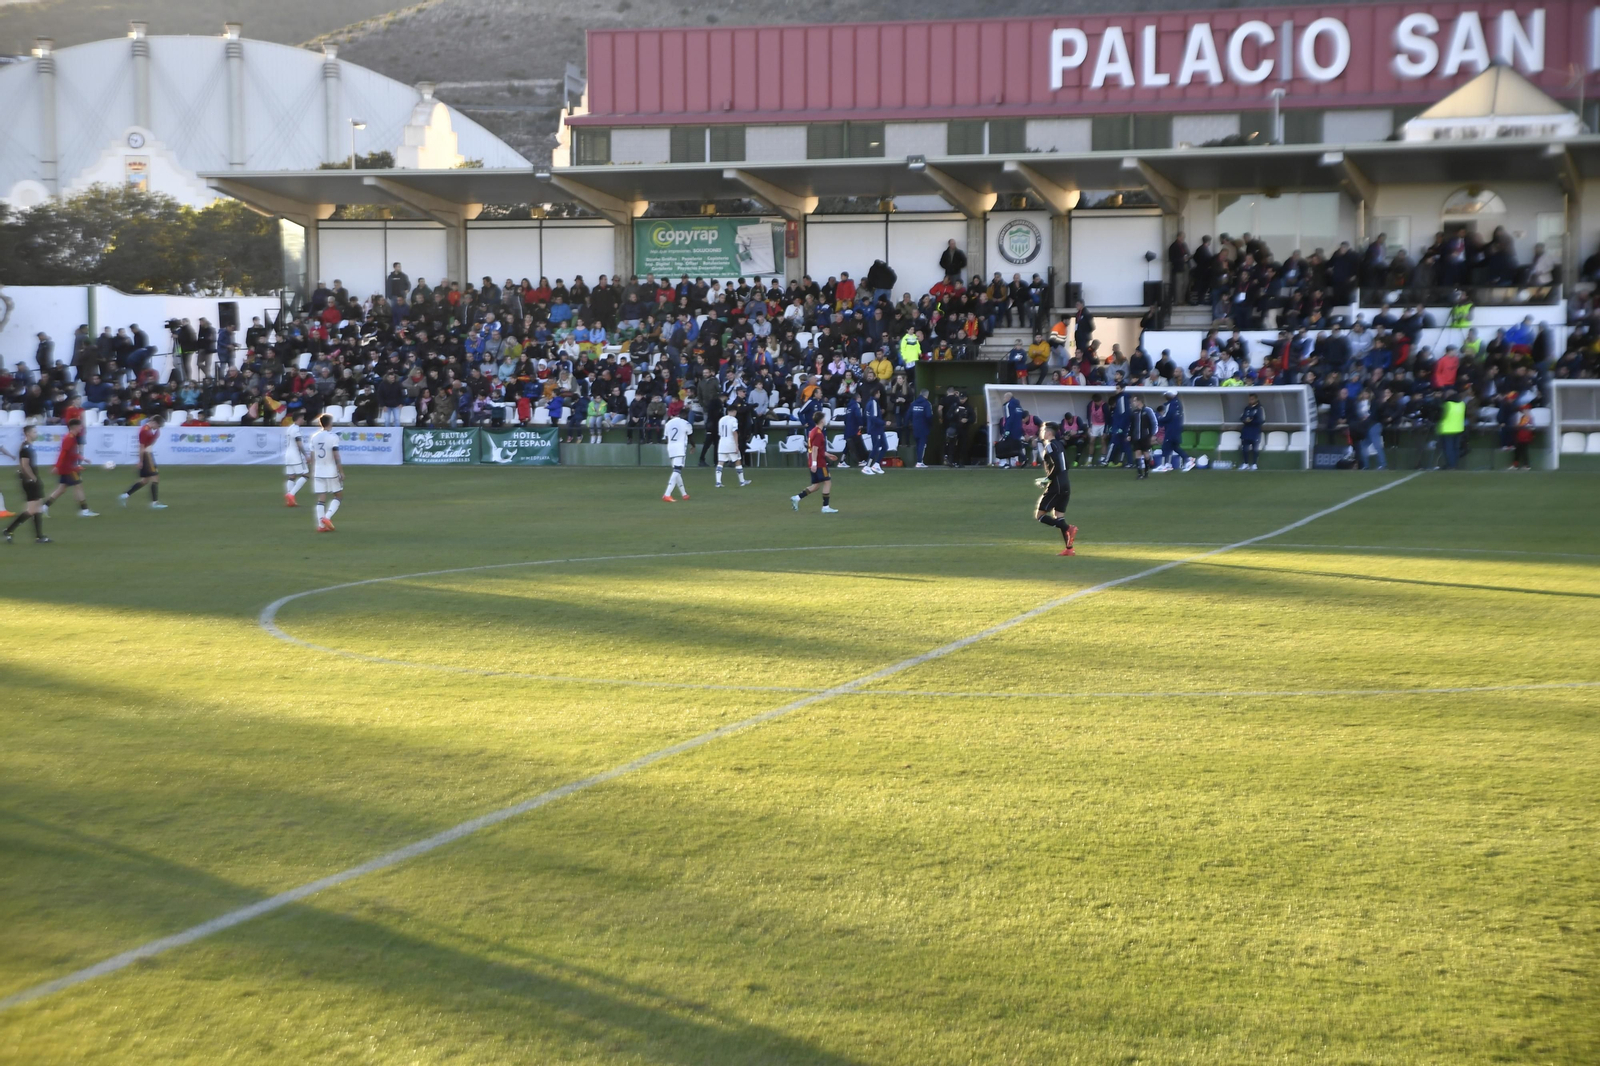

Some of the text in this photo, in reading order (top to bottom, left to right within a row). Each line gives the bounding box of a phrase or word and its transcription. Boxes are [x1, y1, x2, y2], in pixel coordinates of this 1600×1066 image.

[1050, 16, 1351, 90] PALACIO
[1394, 8, 1546, 78] SAN
[657, 228, 719, 245] copyrap
[670, 427, 679, 441] 2
[722, 425, 728, 438] 11
[317, 442, 326, 459] 3
